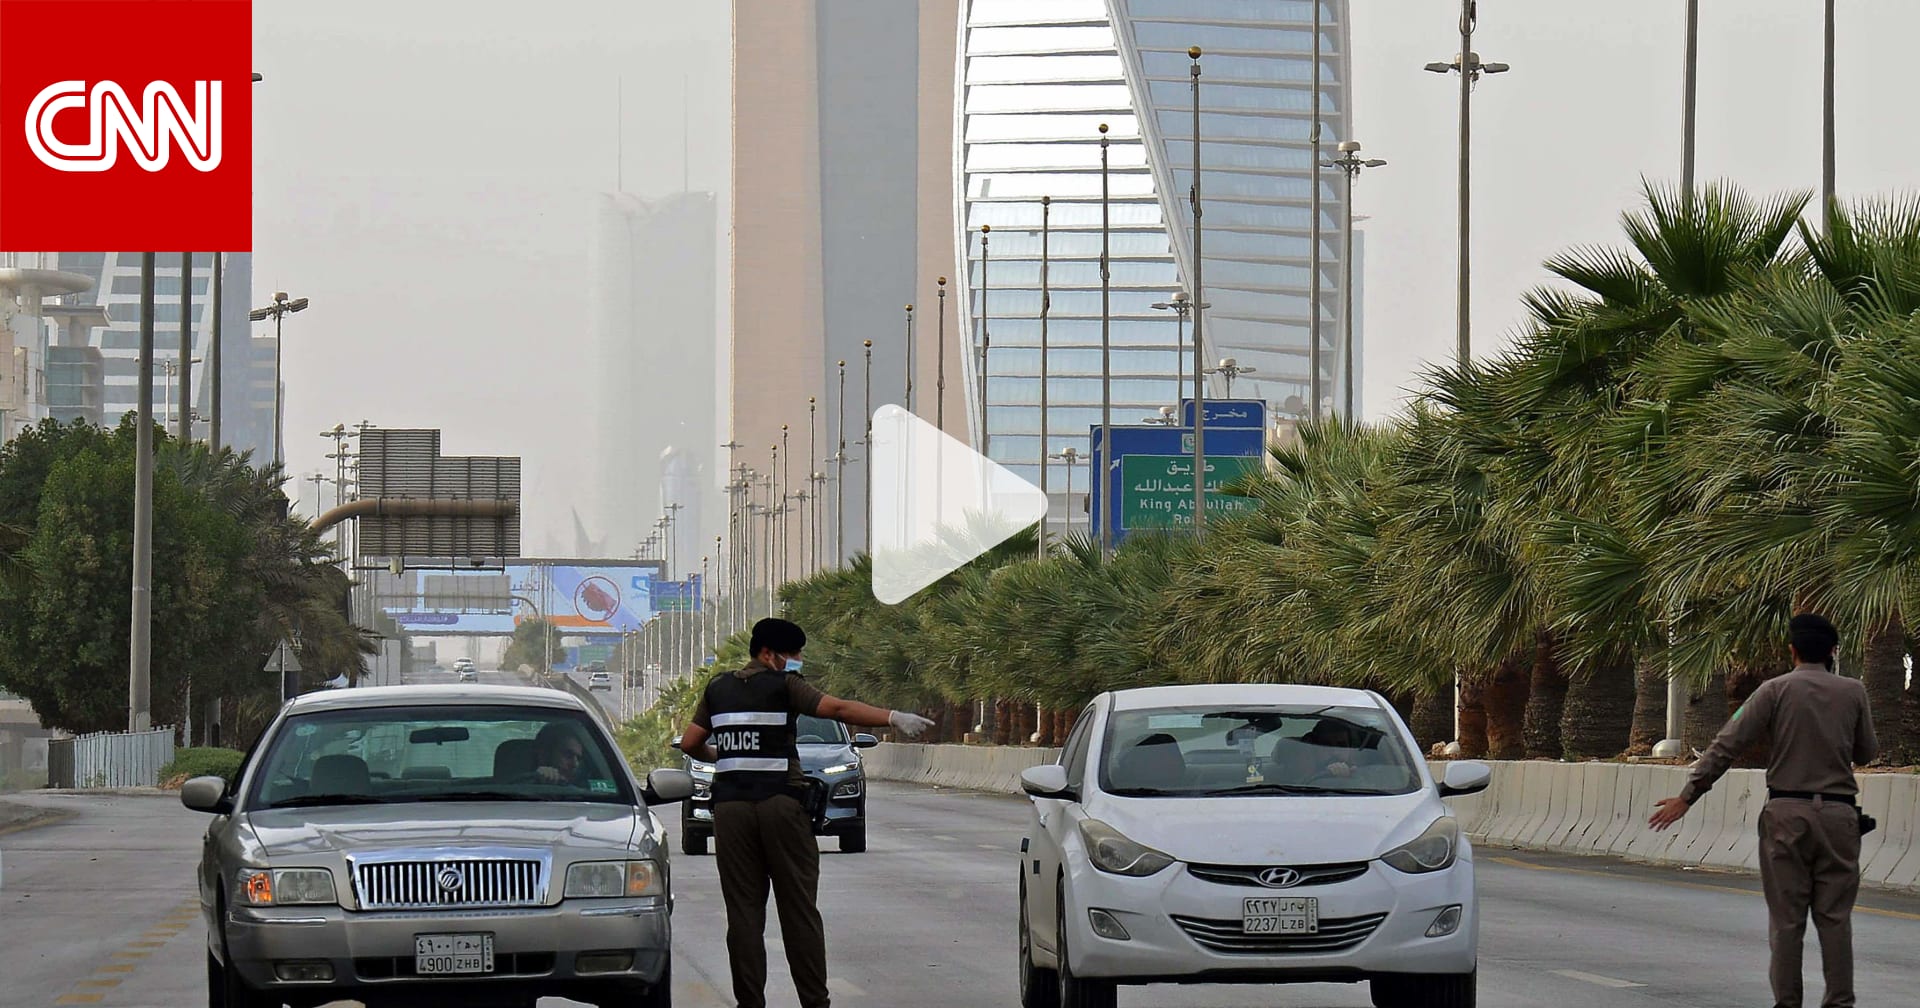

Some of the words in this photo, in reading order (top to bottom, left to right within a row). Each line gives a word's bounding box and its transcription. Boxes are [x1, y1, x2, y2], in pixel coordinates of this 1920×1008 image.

[1166, 460, 1216, 476] طيق
[1139, 498, 1172, 513] King
[1177, 498, 1244, 511] Abullah
[717, 731, 760, 751] POLICE
[1246, 917, 1278, 932] 2237
[1281, 919, 1305, 930] LZB
[419, 957, 453, 972] 4900
[456, 958, 480, 970] ZHB
